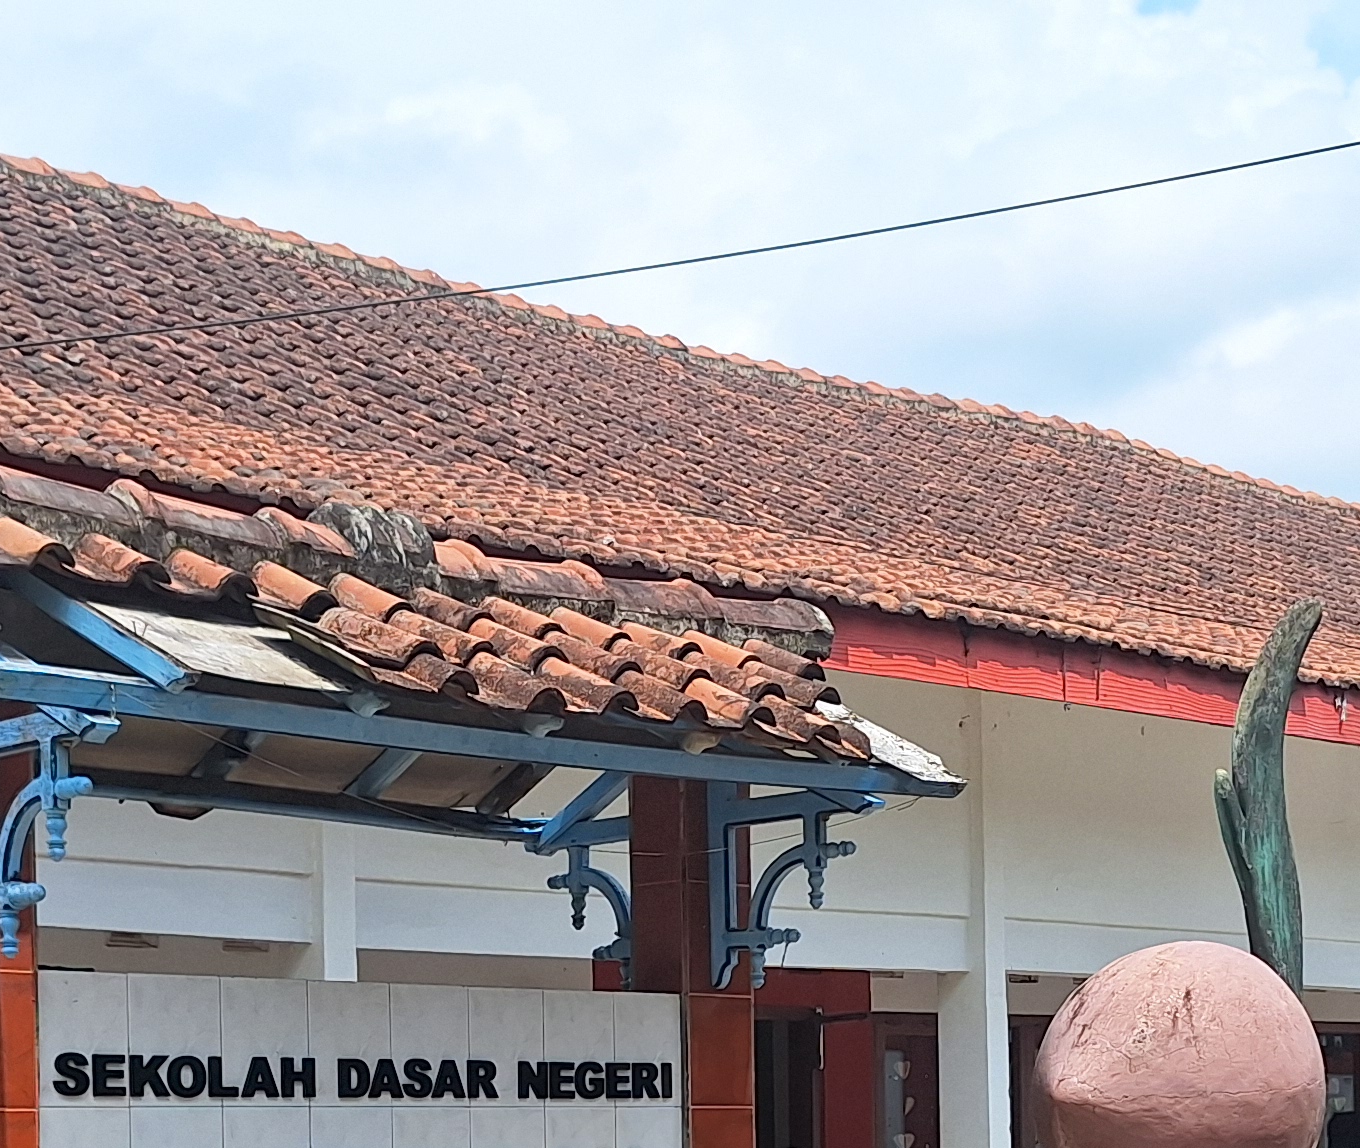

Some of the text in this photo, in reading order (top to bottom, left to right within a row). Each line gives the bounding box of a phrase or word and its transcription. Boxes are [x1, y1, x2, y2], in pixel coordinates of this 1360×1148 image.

[52, 1052, 673, 1100] SEKOLAH DASAR NEGERI
